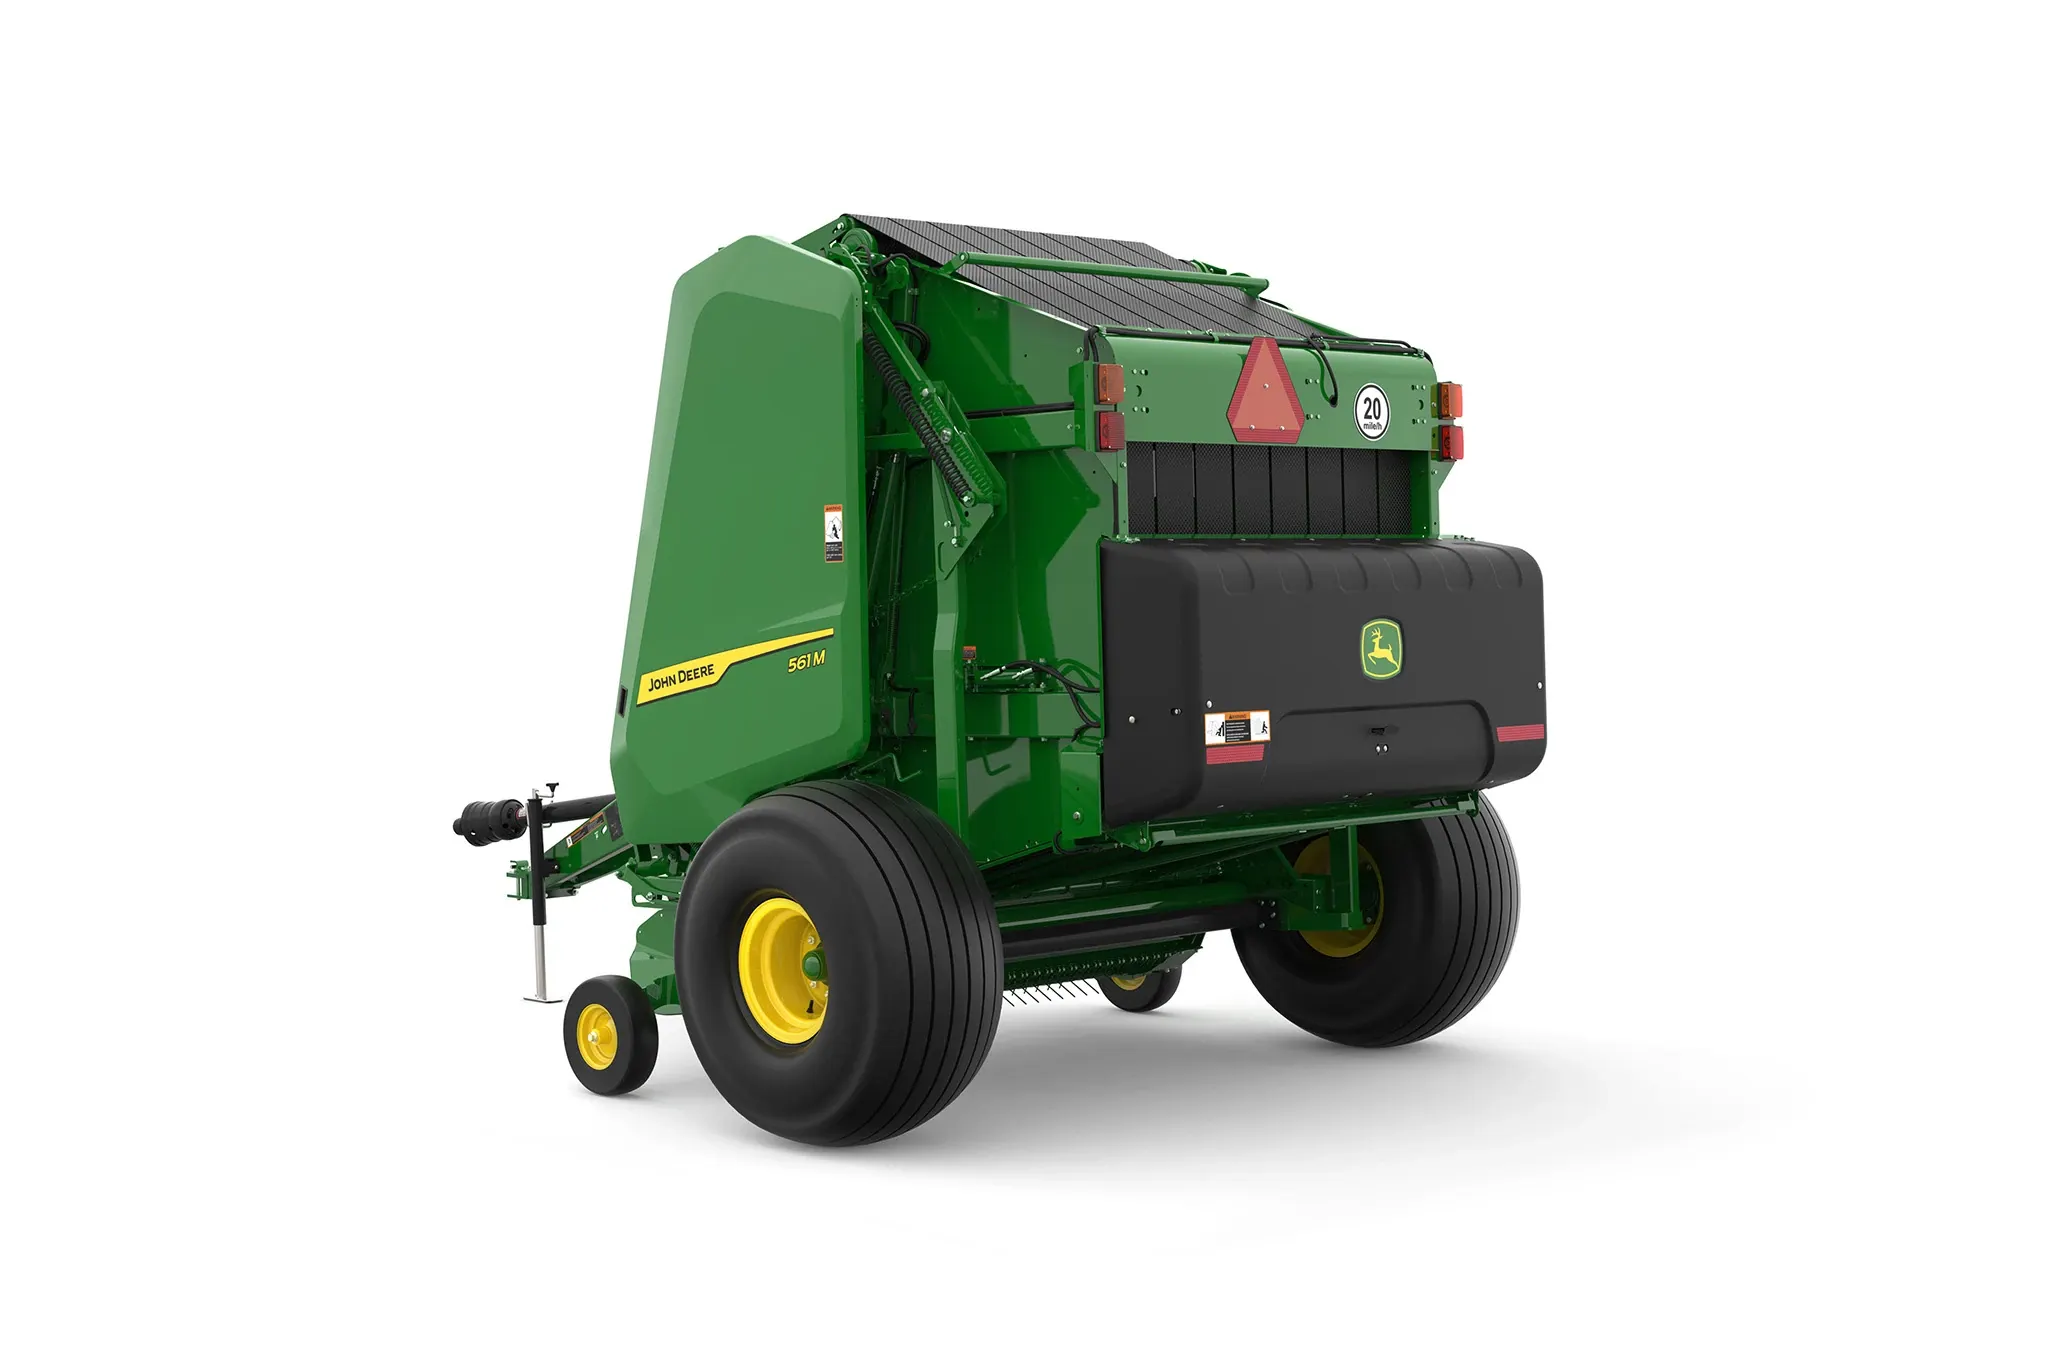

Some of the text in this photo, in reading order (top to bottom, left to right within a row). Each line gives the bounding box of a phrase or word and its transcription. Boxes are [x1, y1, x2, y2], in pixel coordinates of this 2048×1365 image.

[1364, 397, 1381, 420] 20
[649, 664, 714, 692] JOHN DEERE
